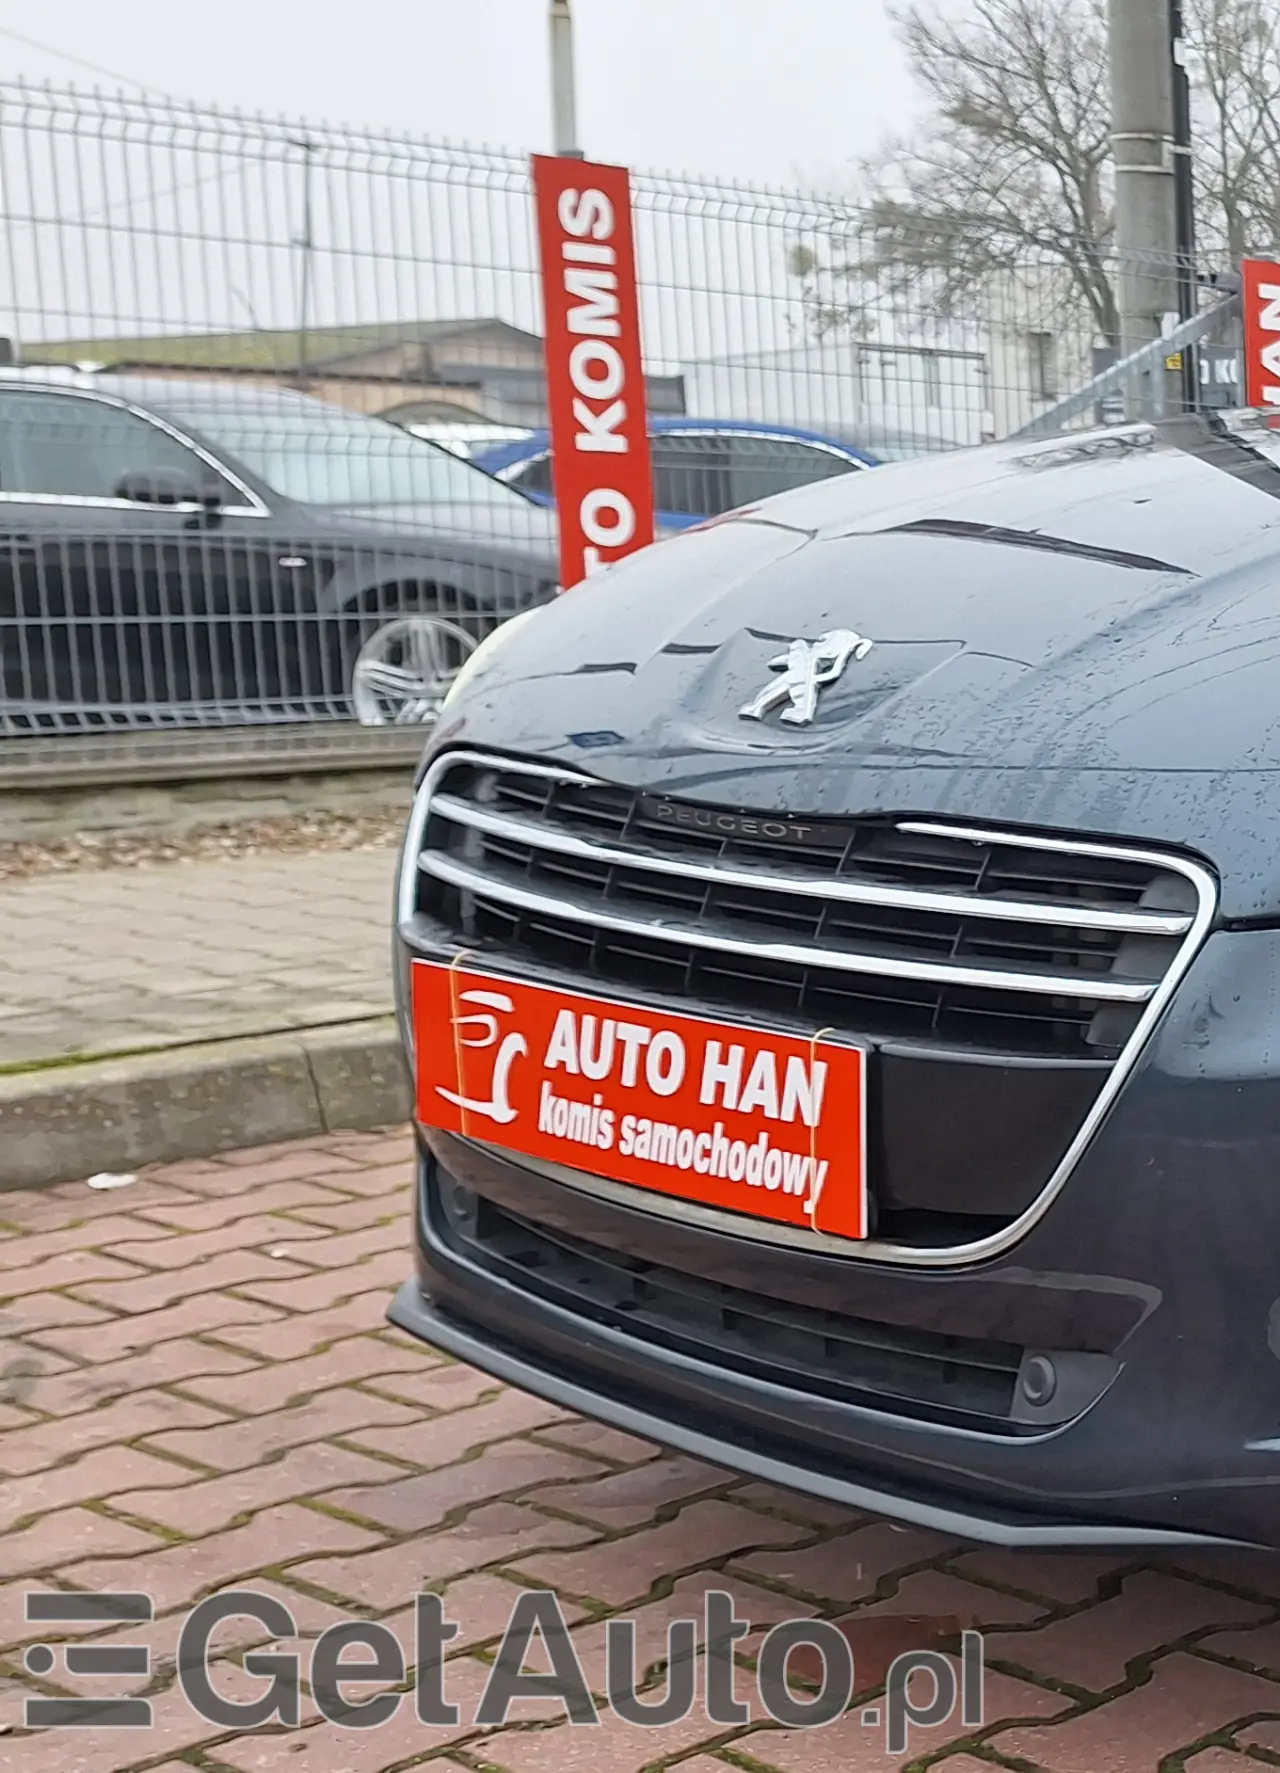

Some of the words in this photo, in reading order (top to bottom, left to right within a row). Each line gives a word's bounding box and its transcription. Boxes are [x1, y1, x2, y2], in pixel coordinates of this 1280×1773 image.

[557, 187, 630, 453] KOMIS
[656, 804, 811, 840] PEUGEOT
[543, 1009, 687, 1096] AUTO
[699, 1040, 829, 1127] HAN
[538, 1080, 614, 1150] komis
[619, 1114, 829, 1214] samochodowy
